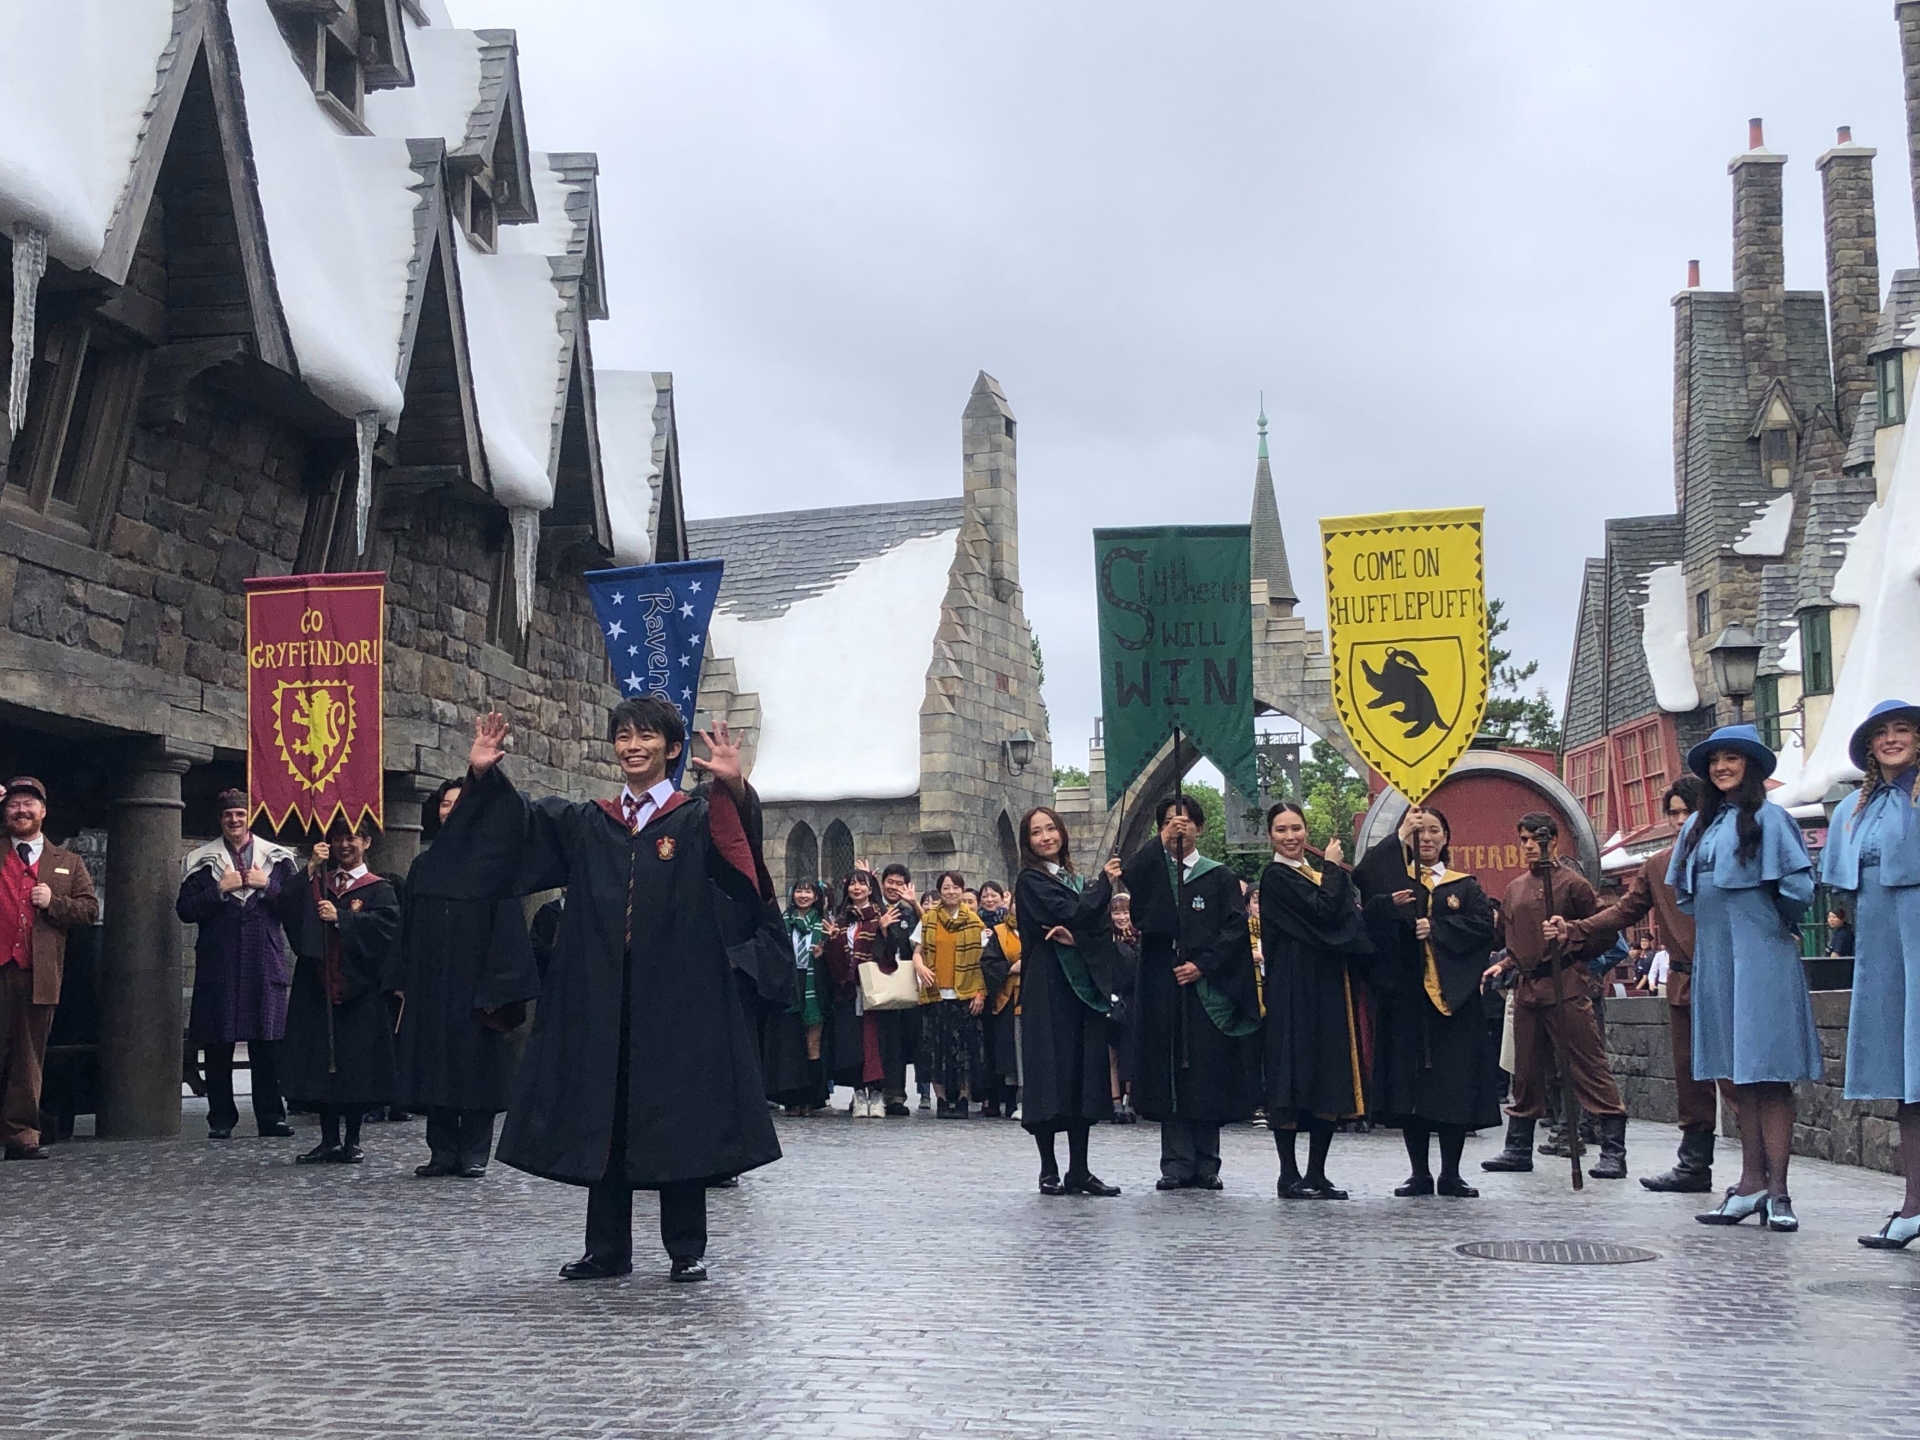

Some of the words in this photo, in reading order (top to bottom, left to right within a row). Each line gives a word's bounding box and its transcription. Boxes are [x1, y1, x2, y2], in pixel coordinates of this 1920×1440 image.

[1353, 549, 1407, 582] COME
[1413, 547, 1440, 578] ON
[301, 606, 323, 634] GO
[1161, 621, 1226, 647] WILL
[249, 639, 378, 669] GRYFFINDOR!
[1114, 657, 1237, 707] WIN
